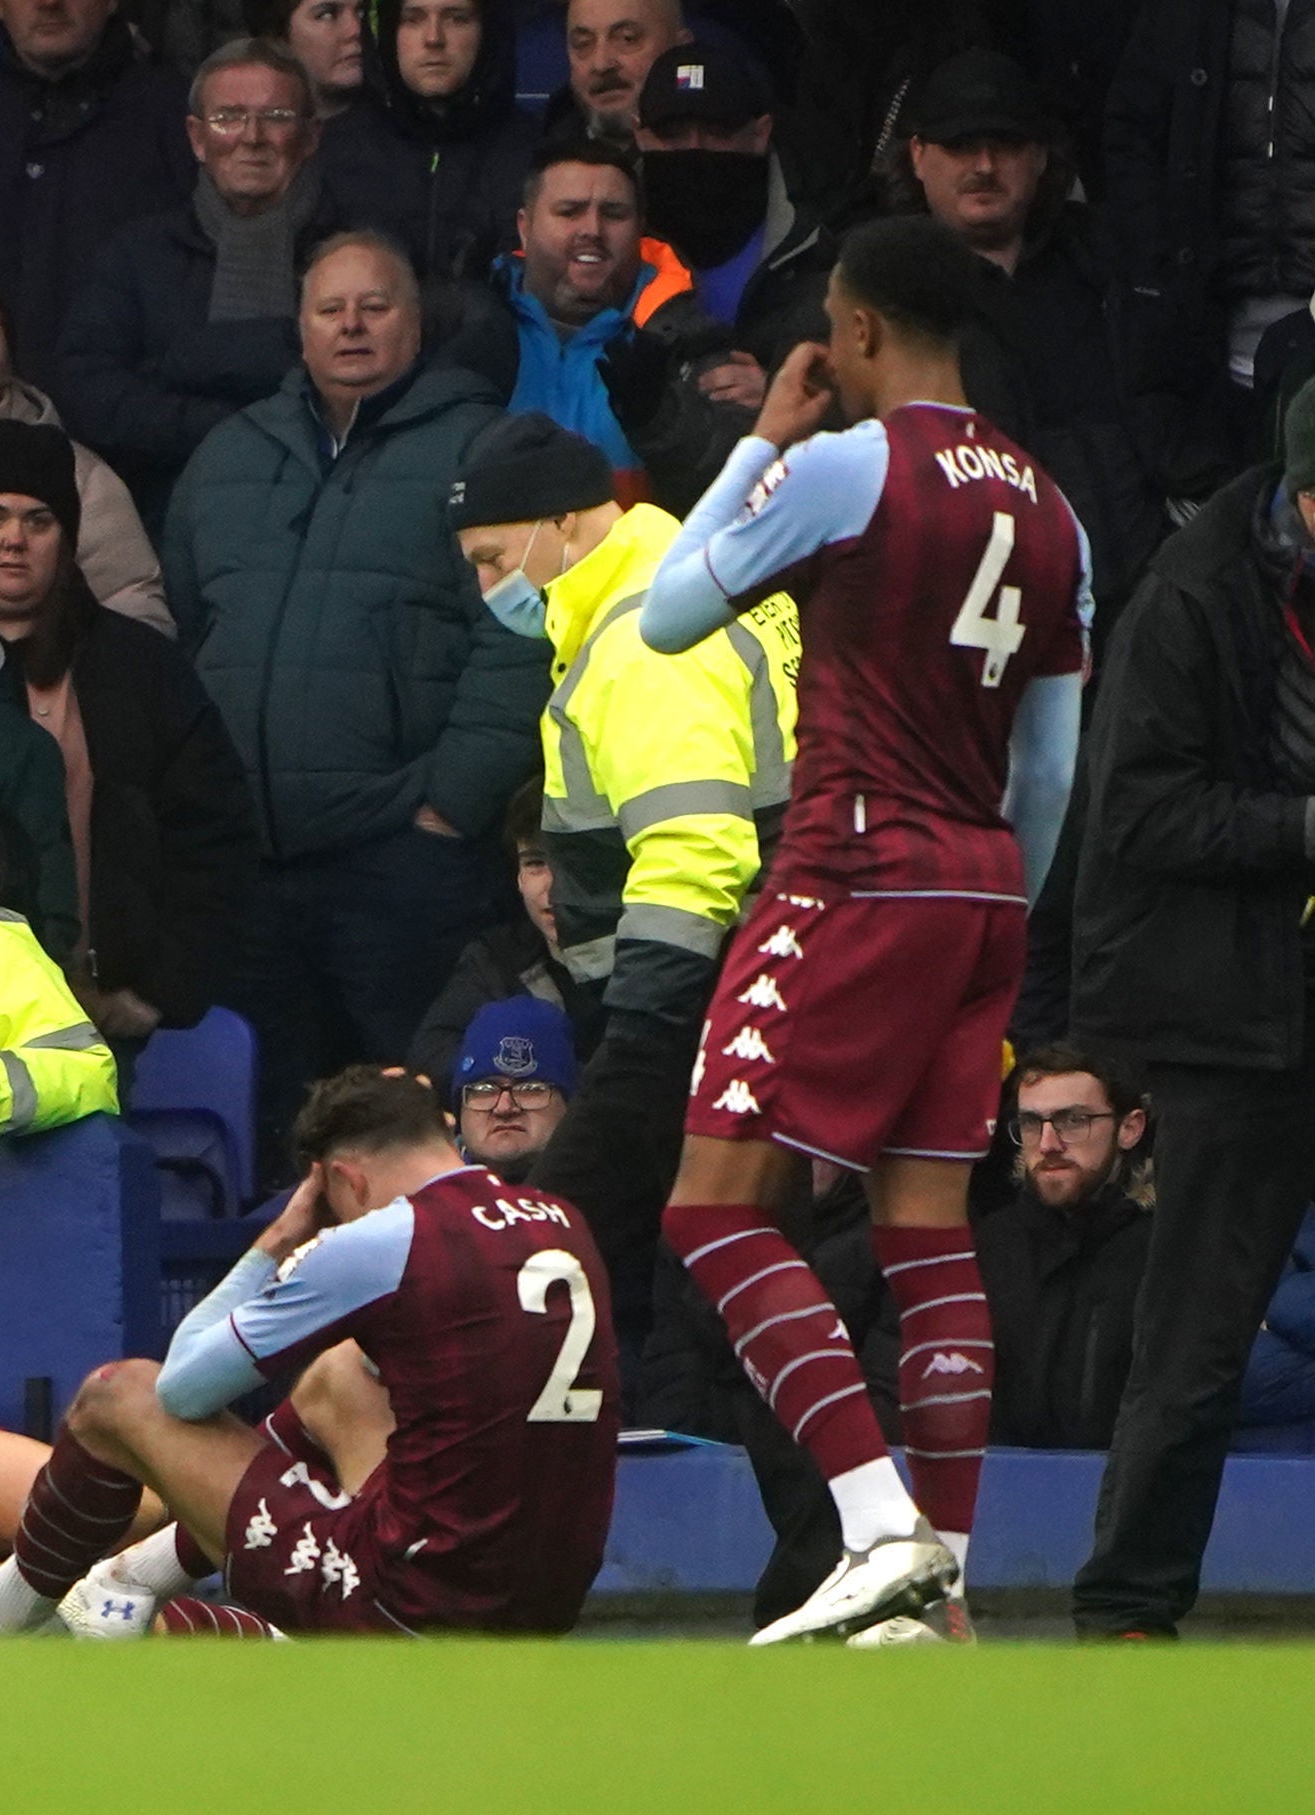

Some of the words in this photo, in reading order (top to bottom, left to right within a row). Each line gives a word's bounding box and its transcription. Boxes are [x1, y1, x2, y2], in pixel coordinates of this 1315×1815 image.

[935, 445, 1038, 504] KONSA
[949, 510, 1027, 688] 4
[471, 1198, 571, 1231] CASH
[517, 1248, 604, 1422] 2
